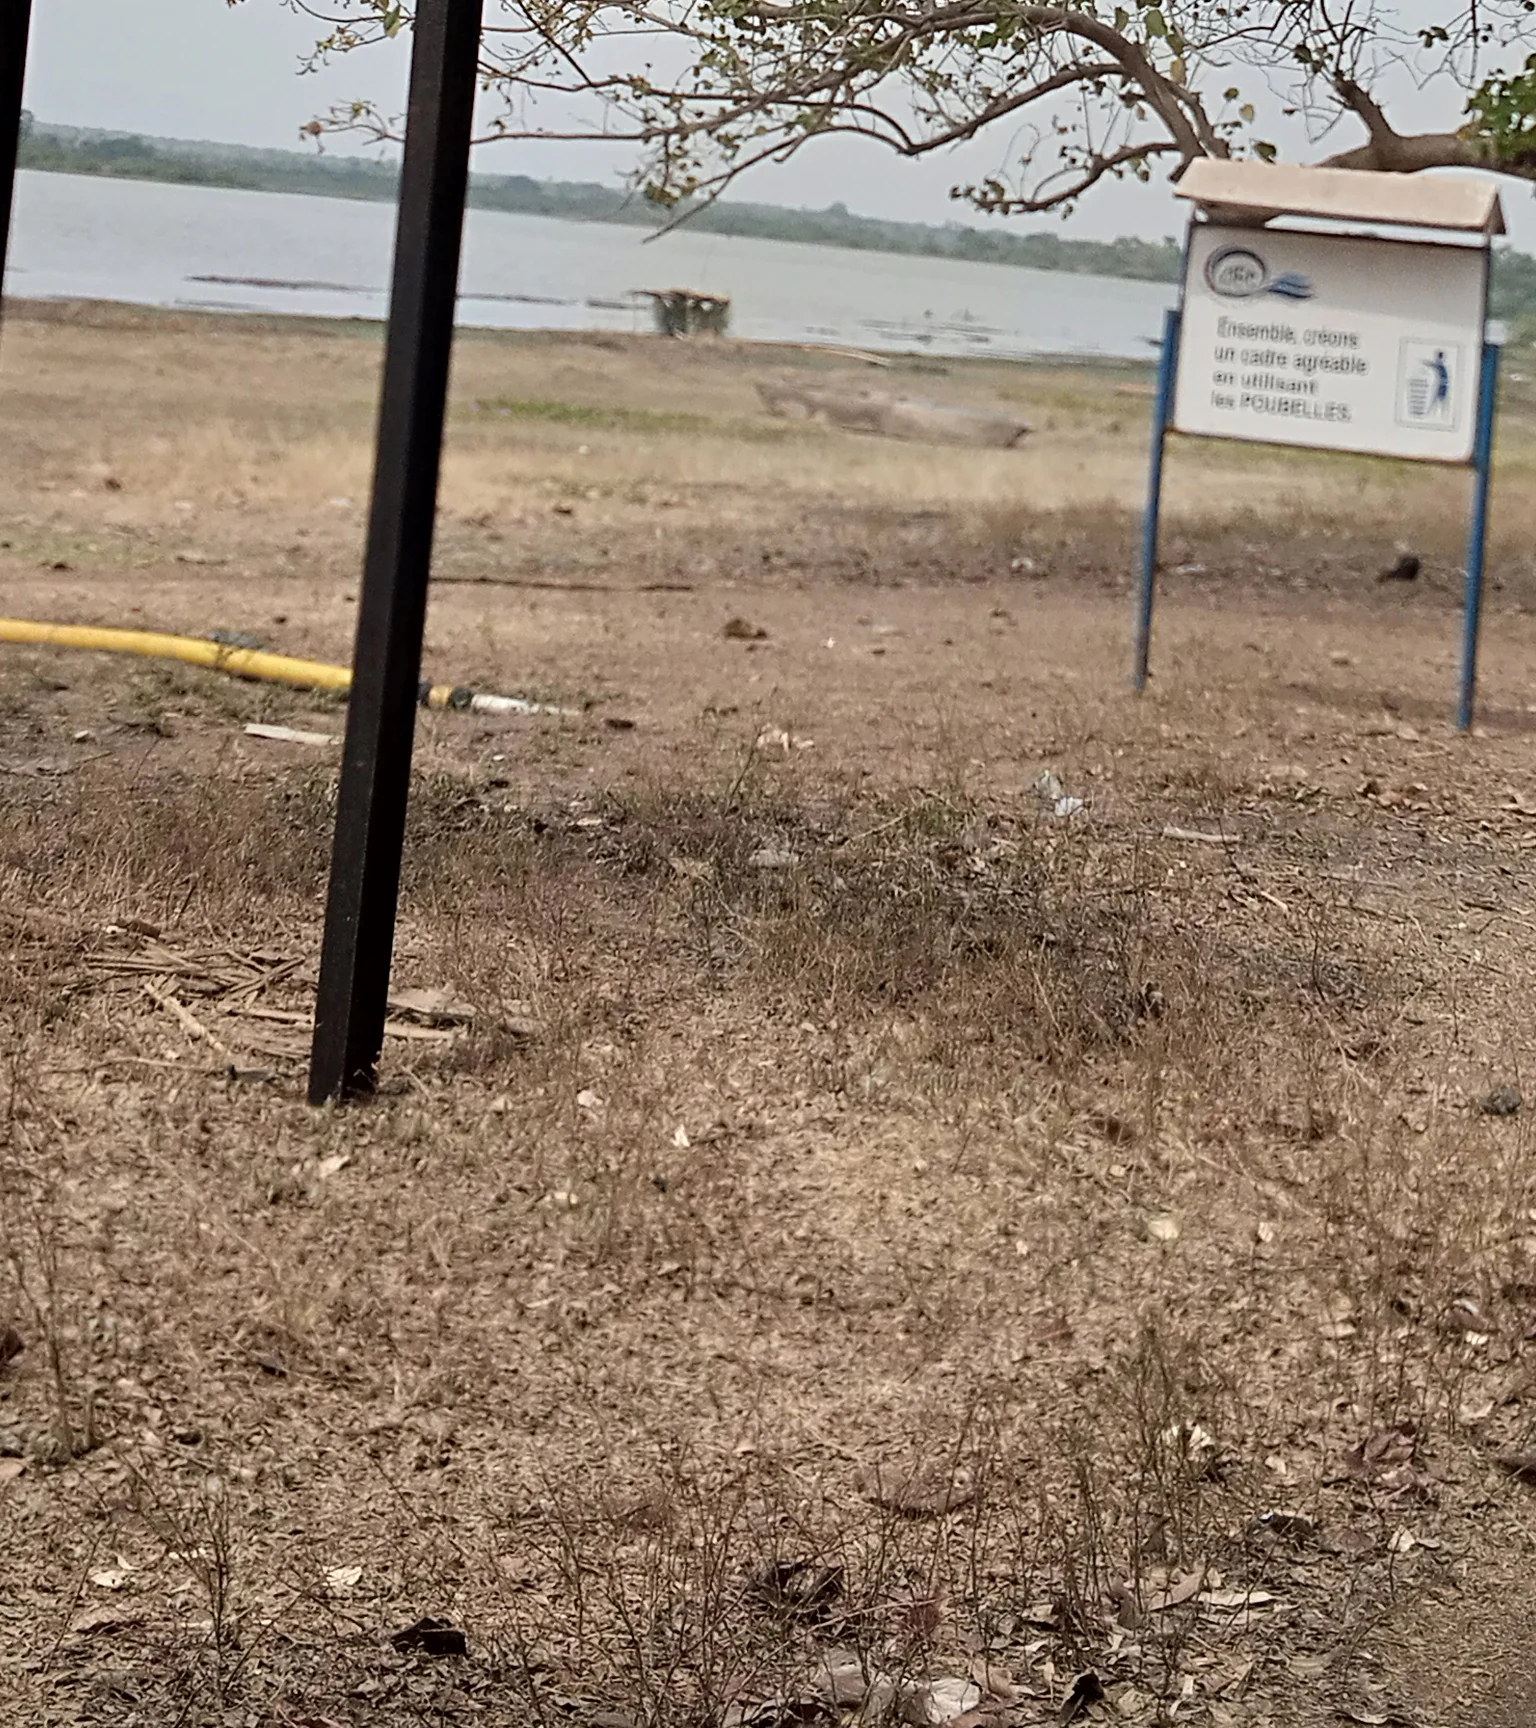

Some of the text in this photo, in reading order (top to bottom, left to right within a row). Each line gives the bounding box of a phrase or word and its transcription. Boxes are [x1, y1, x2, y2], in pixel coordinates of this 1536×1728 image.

[1214, 345, 1235, 363] un
[1240, 348, 1288, 368] cadre
[1213, 371, 1317, 395] en utilisant
